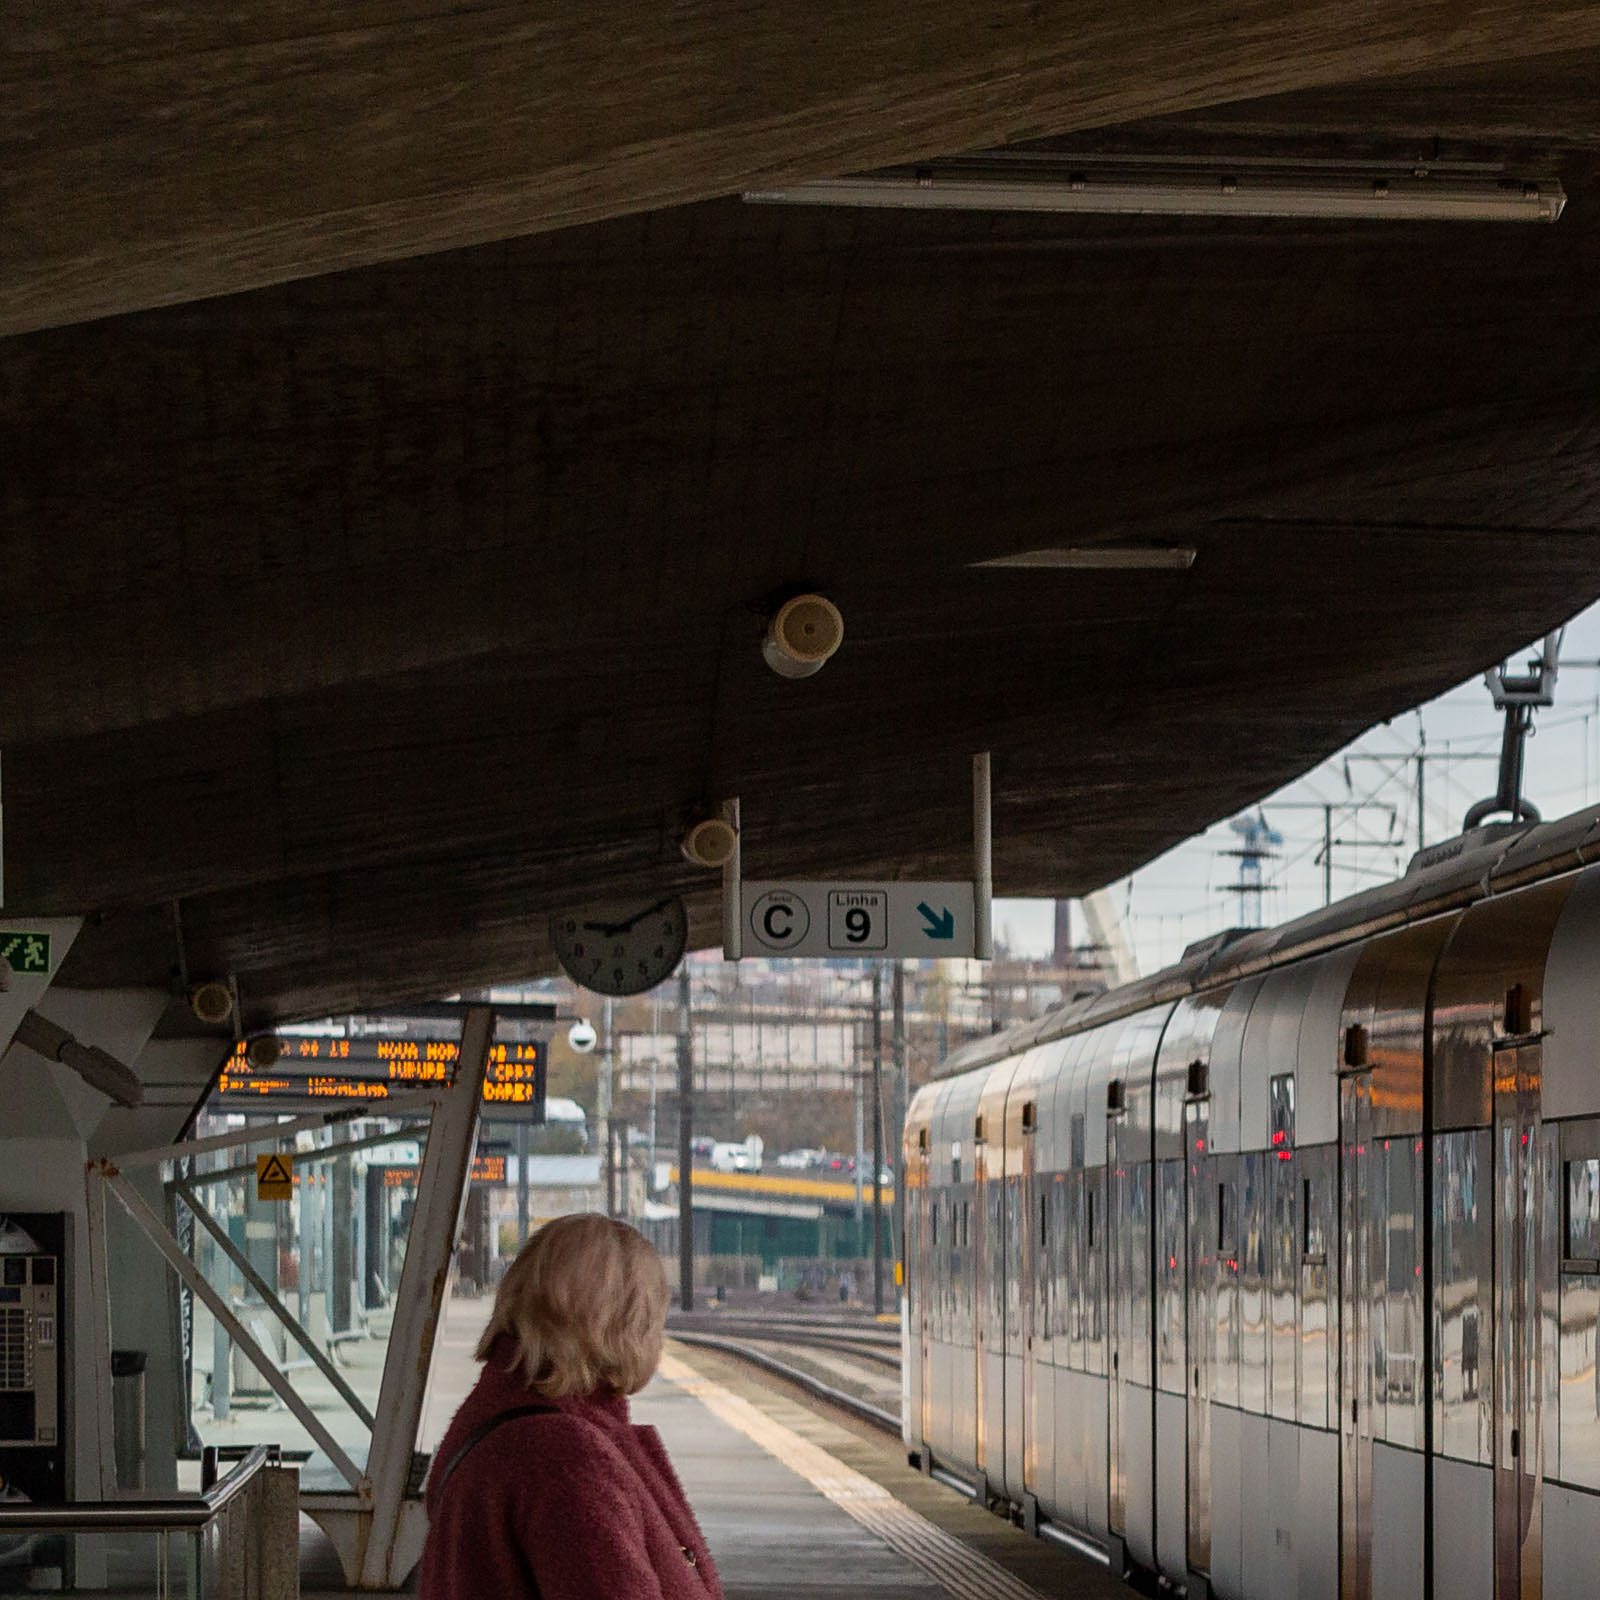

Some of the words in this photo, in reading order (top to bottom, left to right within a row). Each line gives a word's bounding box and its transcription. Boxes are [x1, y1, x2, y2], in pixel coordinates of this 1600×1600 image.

[836, 893, 878, 907] Linha
[763, 904, 794, 939] C
[845, 907, 872, 943] 9
